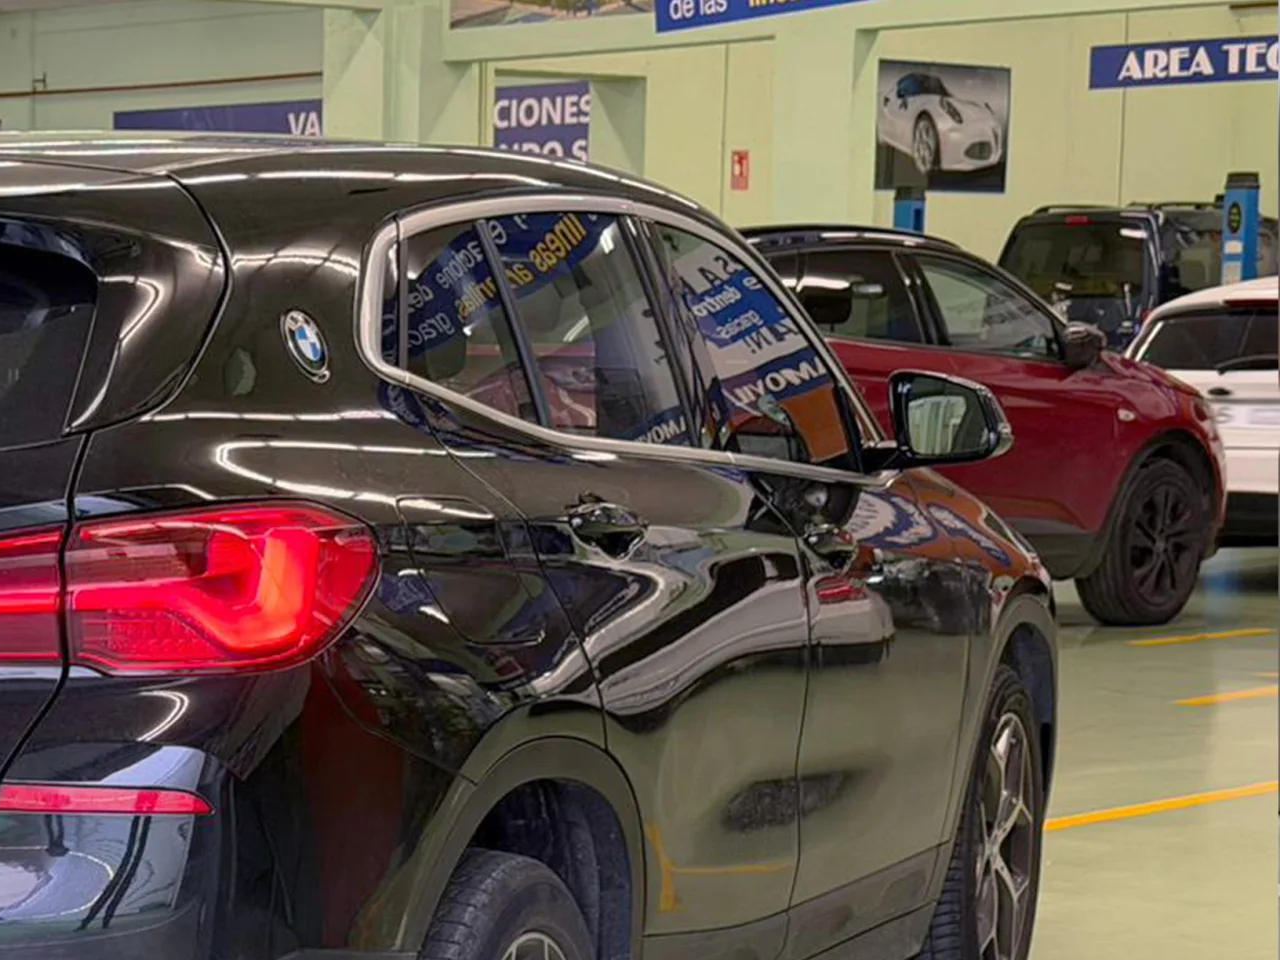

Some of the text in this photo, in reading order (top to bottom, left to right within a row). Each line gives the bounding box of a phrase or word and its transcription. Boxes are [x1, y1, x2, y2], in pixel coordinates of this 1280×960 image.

[669, 0, 695, 20] de
[699, 0, 728, 16] las
[1117, 46, 1215, 81] AREA
